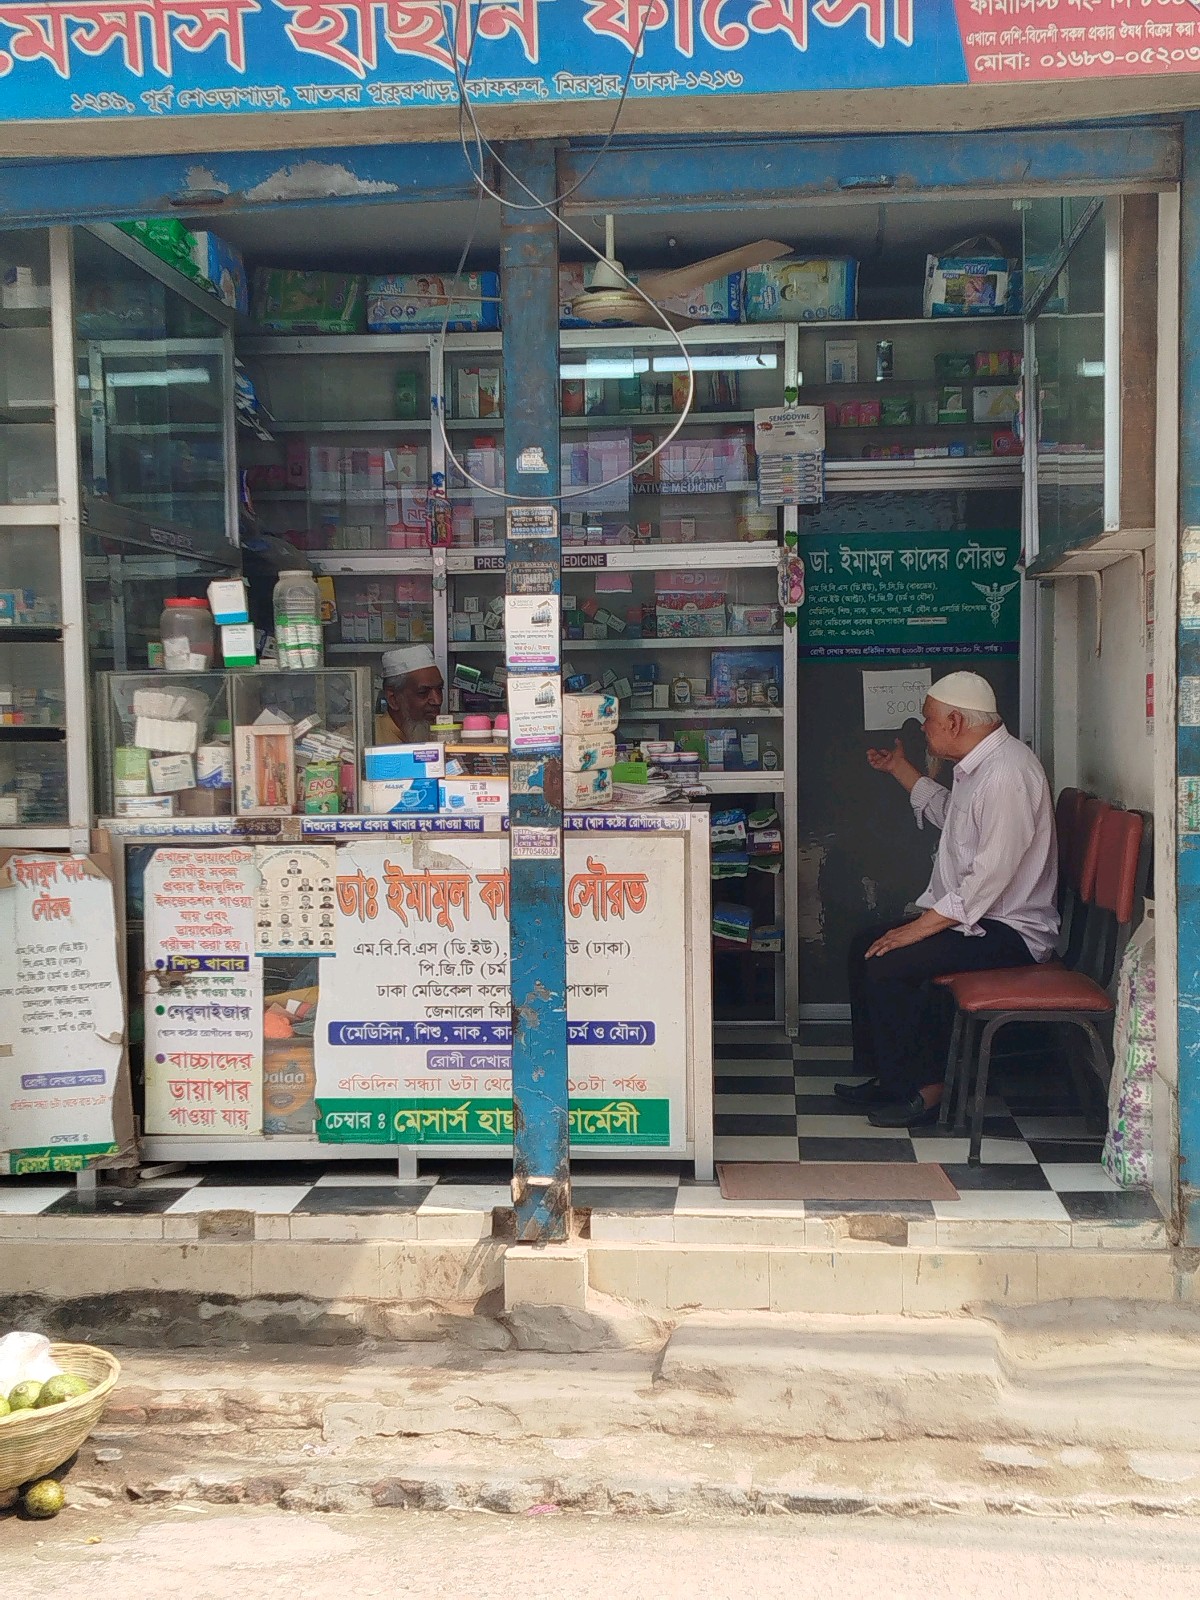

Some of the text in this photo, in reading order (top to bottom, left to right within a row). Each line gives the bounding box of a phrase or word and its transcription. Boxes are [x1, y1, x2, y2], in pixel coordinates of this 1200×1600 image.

[966, 30, 997, 46] এখানে
[999, 23, 1058, 45] দেশি-বিদেশী
[1060, 26, 1086, 42] সকল
[1088, 25, 1116, 41] প্রকার
[1119, 20, 1143, 39] ঔষধ
[1144, 19, 1173, 38] বিক্রয়
[1175, 21, 1195, 37] করা
[140, 85, 174, 114] পূর্ব
[176, 84, 291, 110] শেওড়াপাড়া,
[293, 83, 363, 104] মাতবর
[366, 80, 459, 105] পুকুরপাড়,
[464, 75, 548, 98] কাফরুল,
[630, 70, 743, 92] ঢাকা-১২১৬
[768, 413, 811, 422] SENSODYNE
[671, 482, 723, 493] MEDICINE
[562, 554, 604, 567] EDICINE
[809, 540, 1007, 577] ডা. ইমামুল কাদের সৌরভ
[308, 778, 334, 791] ENO
[303, 817, 480, 832] শিশুদের সকল প্রকার খাবার দুধ পাওয়া যায়
[572, 817, 584, 830] হয়
[628, 814, 662, 829] রোগীদের
[154, 851, 193, 864] এখানে
[194, 849, 253, 864] ডায়াবেটিস
[209, 866, 239, 878] সকল
[162, 878, 246, 896] প্রকার ইনসুলিন
[337, 868, 378, 923] ডাঃ
[383, 859, 472, 932] ইমামুল
[568, 857, 649, 923] সৌরভ
[31, 891, 72, 922] সৌরভ
[218, 896, 254, 908] পাওয়া
[179, 910, 229, 923] যায় এবং
[174, 922, 235, 937] ডায়াবেটিস
[159, 936, 223, 952] পরীক্ষা করা
[353, 940, 437, 957] এম.বি.বি.এস
[443, 940, 508, 958] (ডি.ইউ),
[585, 940, 632, 958] (ঢাকা)
[170, 955, 246, 971] শিশু খাবার
[418, 959, 506, 979] পি.জি.টি (চর্ম
[200, 988, 229, 998] পাওয়া
[376, 982, 407, 999] ঢাকা
[411, 981, 472, 999] মেডিকেল
[167, 1001, 253, 1024] নেবুলাইজার
[424, 1003, 484, 1020] জেনারেল
[339, 1022, 410, 1043] (মেডিসিন,
[413, 1022, 448, 1043] শিশু,
[453, 1025, 487, 1043] নাক,
[568, 1023, 588, 1040] চর্ম
[592, 1028, 605, 1039] ও
[608, 1022, 648, 1042] যৌন)
[167, 1051, 254, 1071] বাচ্চাদের
[429, 1051, 510, 1069] রোগী দেখার
[166, 1078, 253, 1103] ডায়াপার
[338, 1074, 400, 1092] প্রতিদিন
[404, 1077, 442, 1092] সন্ধ্যা
[447, 1075, 478, 1091] ৬টা
[613, 1073, 648, 1092] পর্যন্ত
[168, 1107, 252, 1127] পাওয়া যায়
[325, 1111, 372, 1130] চেম্বার
[394, 1102, 474, 1134] মেসার্স
